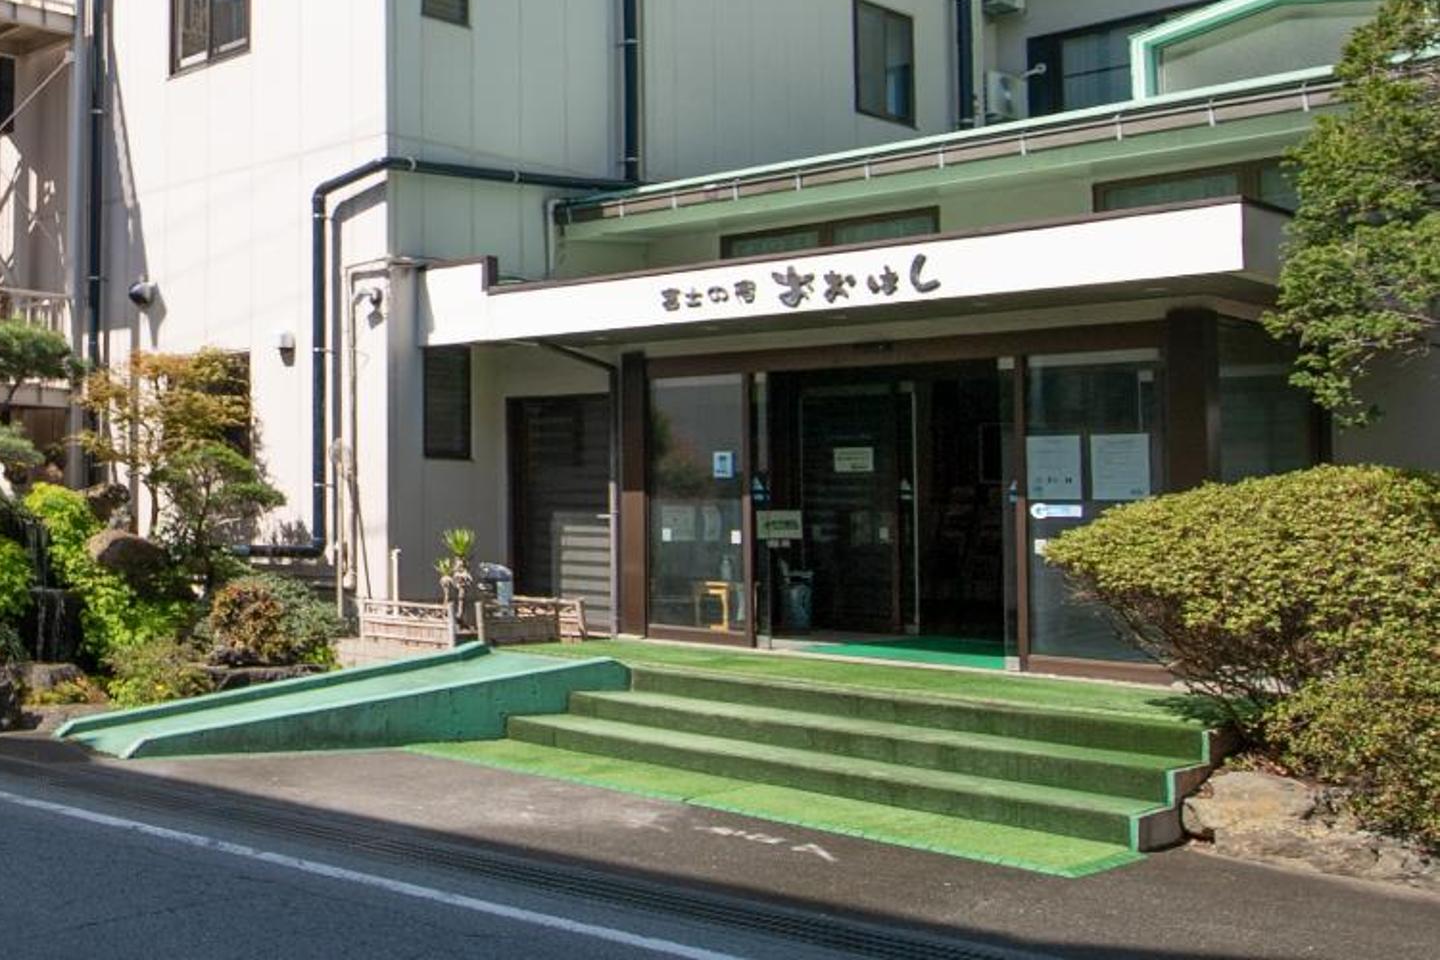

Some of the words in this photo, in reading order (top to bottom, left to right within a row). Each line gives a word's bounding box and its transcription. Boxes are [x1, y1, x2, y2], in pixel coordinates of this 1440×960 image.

[661, 279, 757, 312] 富士の宿
[771, 253, 941, 308] おおはし
